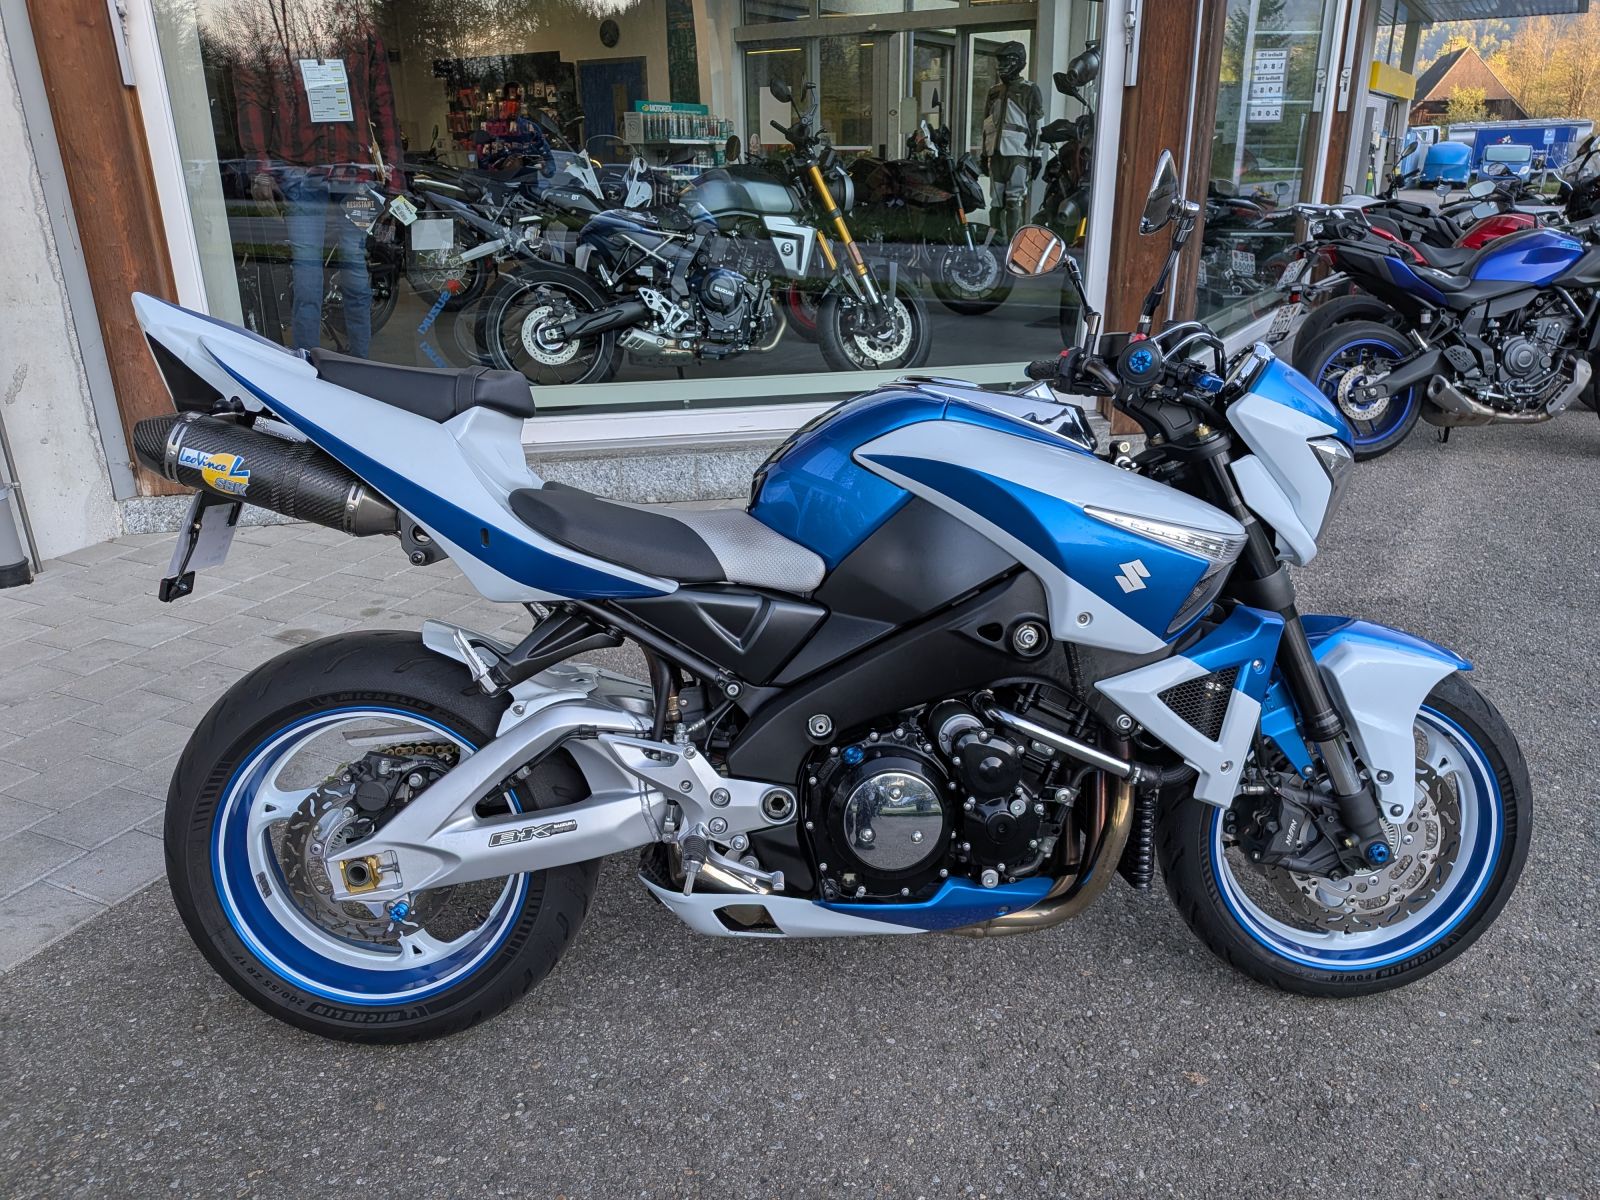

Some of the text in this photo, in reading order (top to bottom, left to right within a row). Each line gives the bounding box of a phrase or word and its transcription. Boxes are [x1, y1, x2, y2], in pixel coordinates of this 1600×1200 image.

[649, 104, 672, 112] MOTOREX
[346, 200, 375, 209] RESISTANT
[714, 285, 735, 297] SUZUKI
[179, 447, 227, 472] LeoVince
[215, 478, 250, 497] SBK
[339, 691, 433, 711] MICHELIN
[1330, 944, 1442, 982] MICHELIN POWER
[247, 967, 262, 979] ZR
[261, 980, 305, 1006] 200/55
[313, 1004, 401, 1021] MICHELIN
